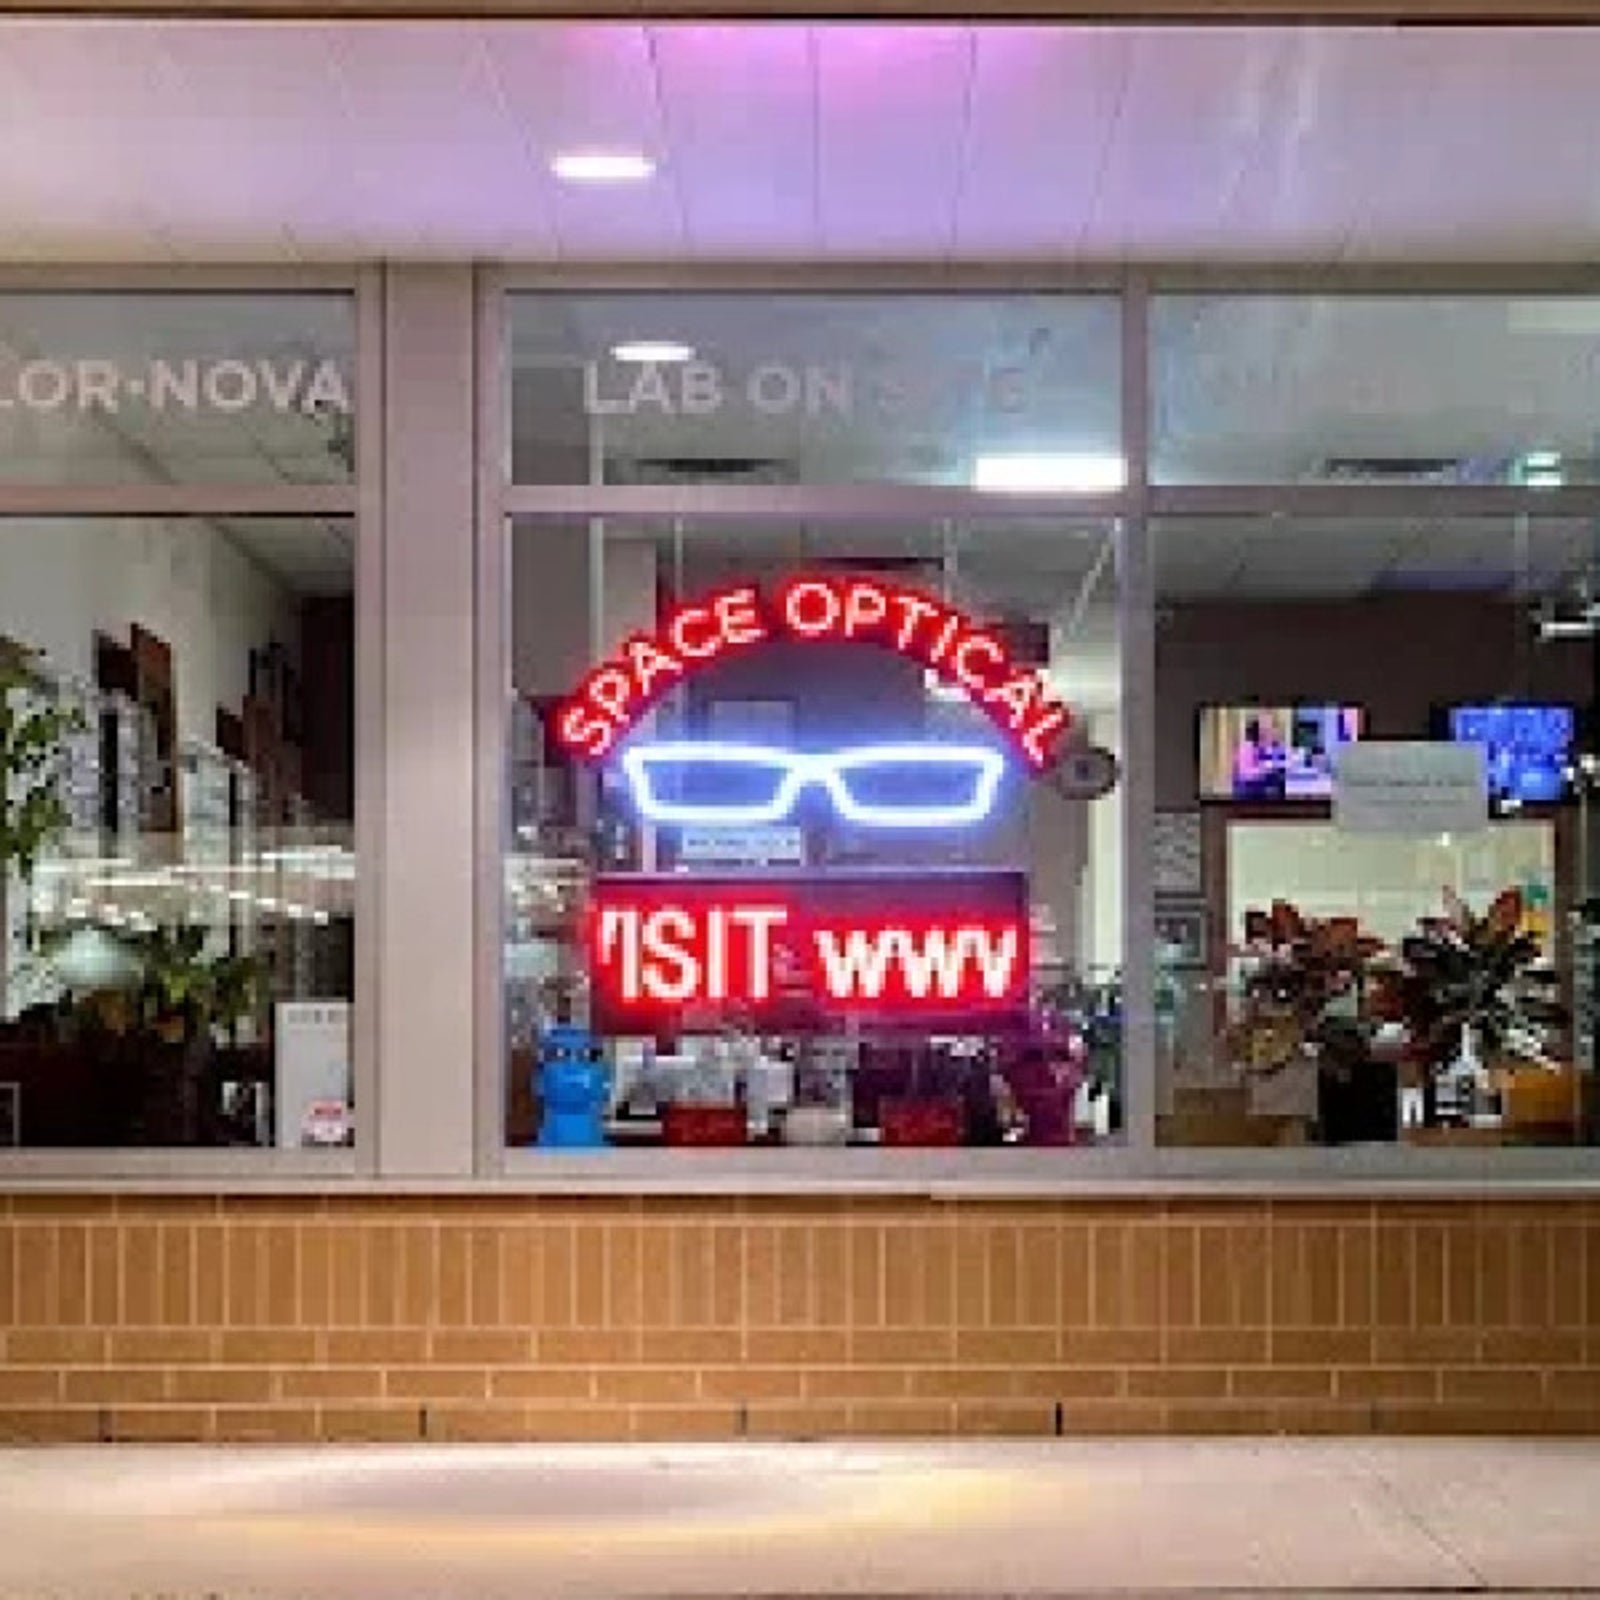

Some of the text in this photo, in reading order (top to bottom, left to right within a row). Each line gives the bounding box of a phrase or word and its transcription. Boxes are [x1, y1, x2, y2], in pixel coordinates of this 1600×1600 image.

[583, 359, 722, 414] LAB
[746, 362, 852, 414] ON
[562, 582, 1066, 767] SPACE OPTICAL
